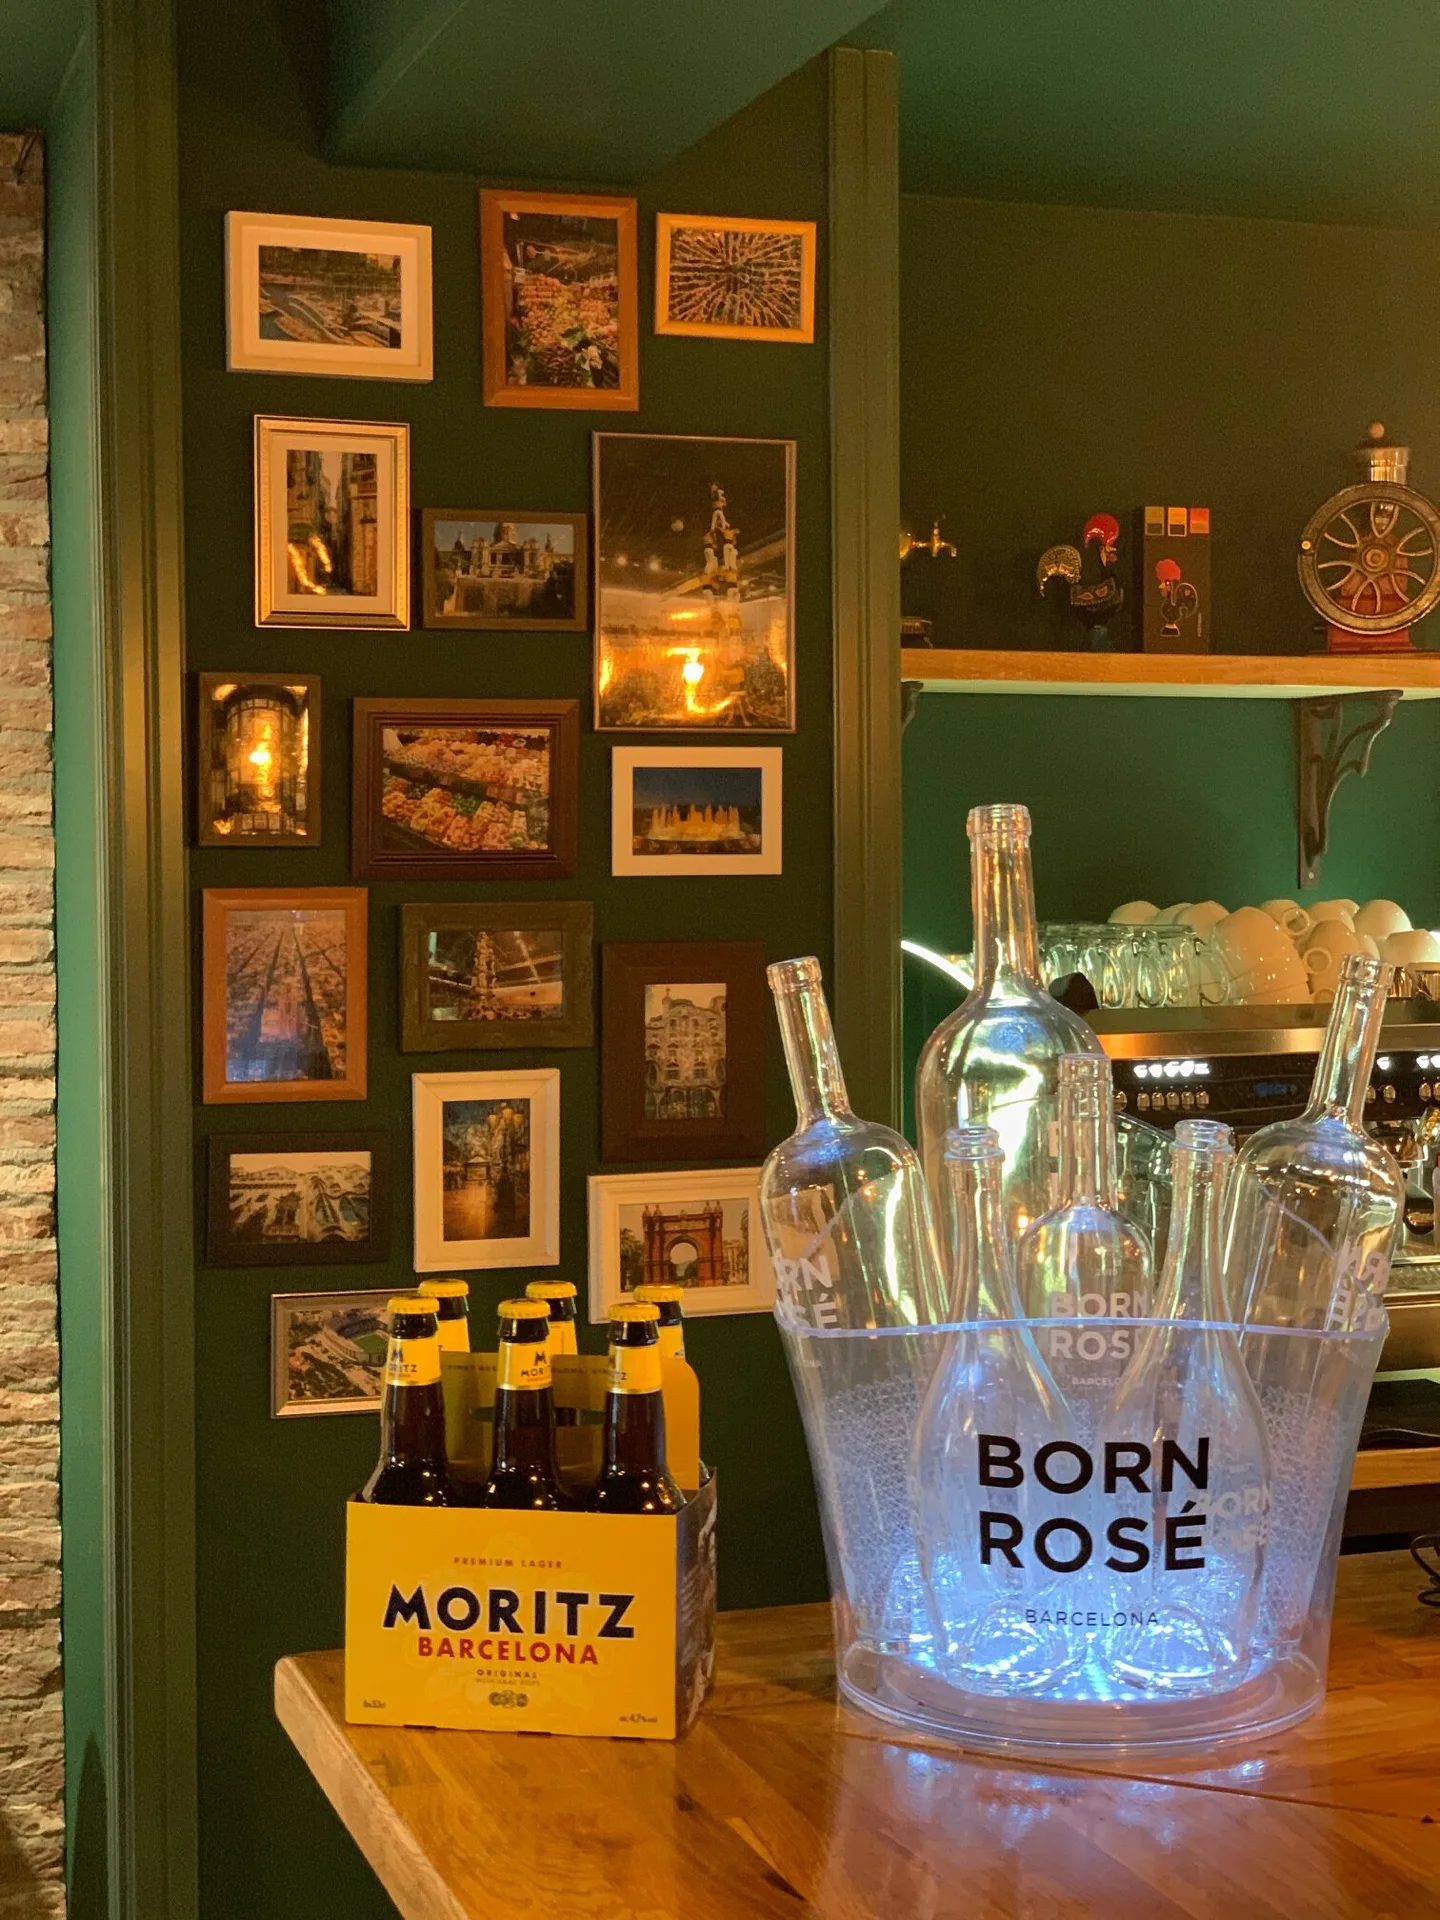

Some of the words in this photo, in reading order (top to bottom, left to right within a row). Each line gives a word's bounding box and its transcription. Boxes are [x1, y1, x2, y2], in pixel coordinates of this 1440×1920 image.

[1071, 1377, 1121, 1386] BARCELO
[978, 1433, 1210, 1495] BORN
[979, 1499, 1207, 1573] ROSÉ
[383, 1583, 635, 1639] MORITZ
[1025, 1609, 1160, 1627] BARCELONA
[418, 1636, 599, 1665] BARCELONA
[476, 1669, 537, 1679] ORIGINAL
